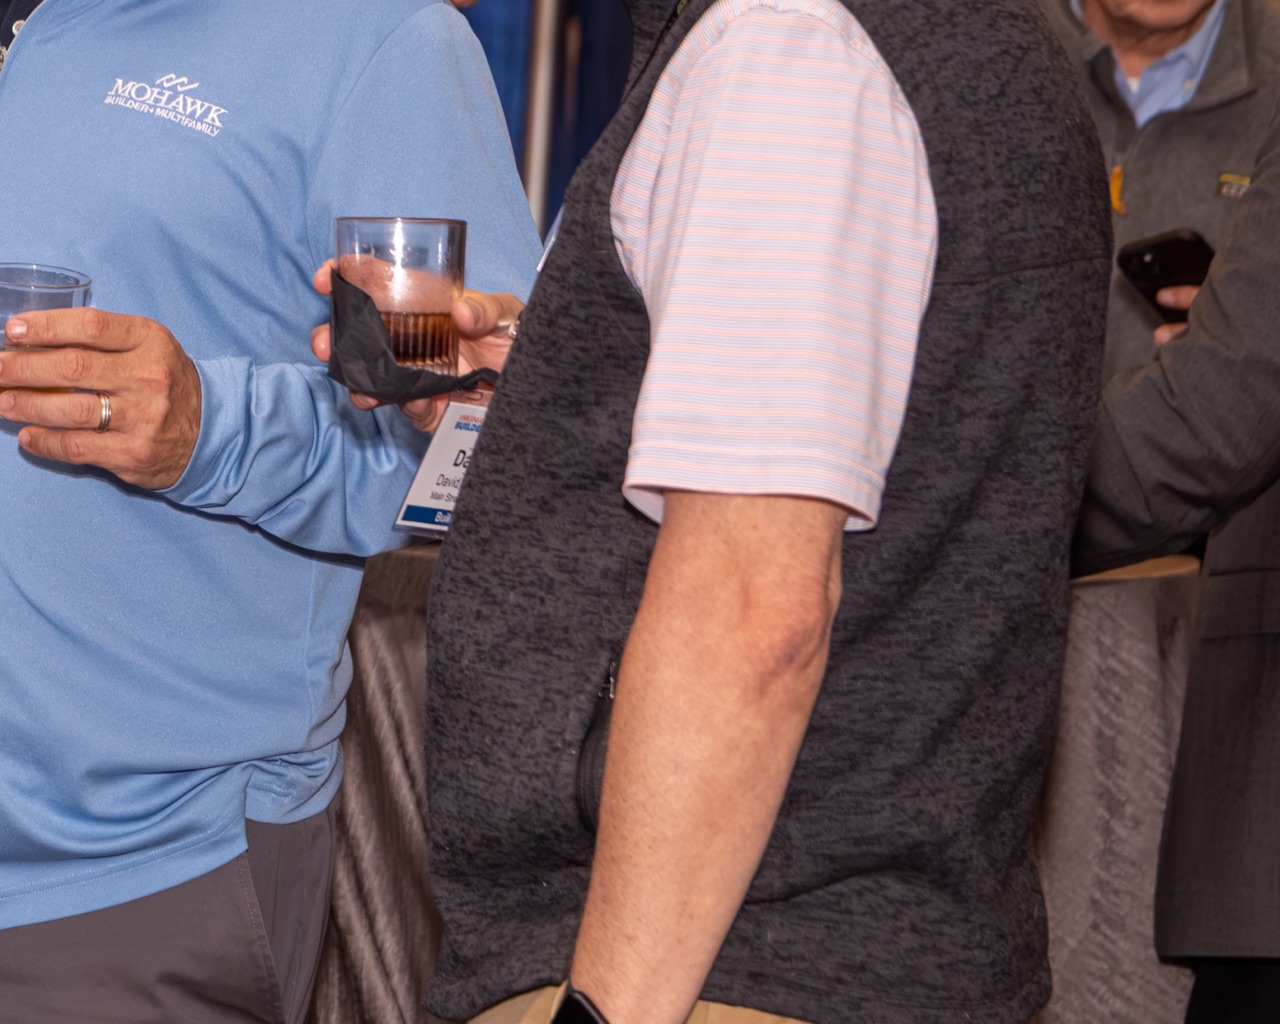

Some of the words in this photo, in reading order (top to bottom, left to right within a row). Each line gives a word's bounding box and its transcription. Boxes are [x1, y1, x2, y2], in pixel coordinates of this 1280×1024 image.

[108, 78, 229, 127] MOHAWK
[452, 449, 471, 468] Da
[434, 511, 452, 523] Buil
